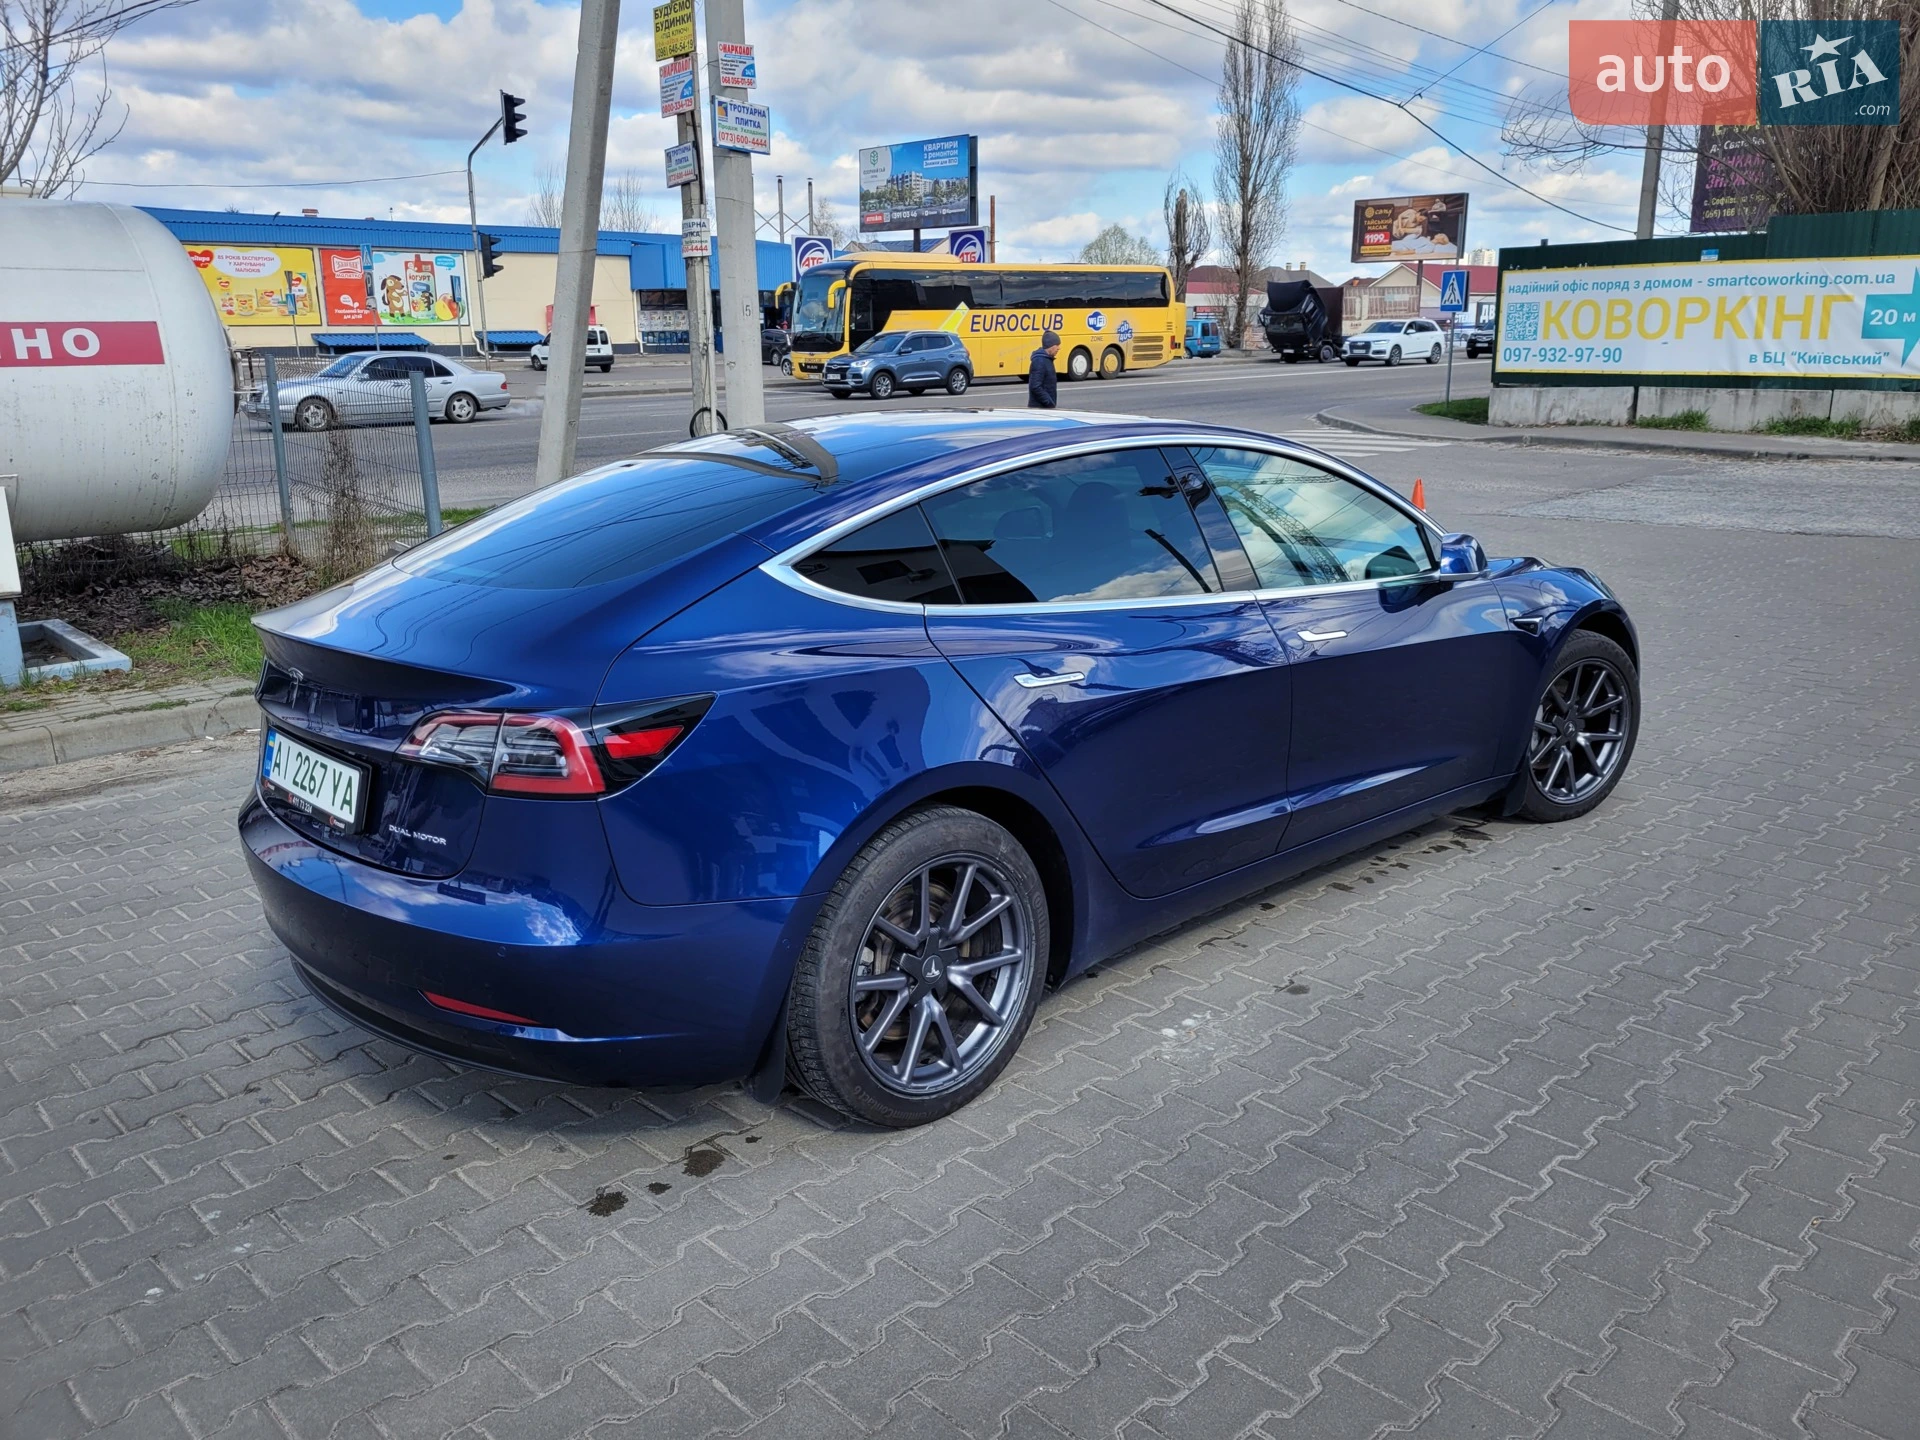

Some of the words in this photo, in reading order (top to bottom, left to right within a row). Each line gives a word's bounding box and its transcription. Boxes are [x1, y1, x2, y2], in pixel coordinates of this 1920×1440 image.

[654, 0, 691, 20] БУДУЄМО
[655, 12, 692, 33] БУДИНКИ
[728, 103, 767, 119] ТРОТУАРНА
[735, 116, 762, 129] ПЛИТКА
[923, 140, 959, 152] КВАРТИРИ
[928, 149, 959, 160] ремонтом
[1365, 233, 1385, 244] 1199
[1508, 280, 1560, 295] надійний
[1562, 279, 1589, 294] офіс
[1592, 279, 1630, 293] поряд
[1634, 281, 1640, 290] з
[1643, 278, 1693, 291] домом
[1707, 272, 1896, 288] smartcoworking.com.ua
[970, 313, 1064, 333] EUROCLUB
[1542, 294, 1856, 341] КОВОРКІНГ
[1869, 309, 1898, 326] 20
[1902, 312, 1917, 323] м
[0, 327, 101, 360] НО
[1503, 347, 1623, 363] 097-932-97-90
[1749, 354, 1758, 364] в
[1762, 351, 1785, 366] БЦ
[272, 740, 291, 781] AI
[292, 751, 329, 799] 2267
[332, 767, 353, 816] YA
[389, 824, 411, 837] DUAL
[413, 831, 447, 846] MOTOR
